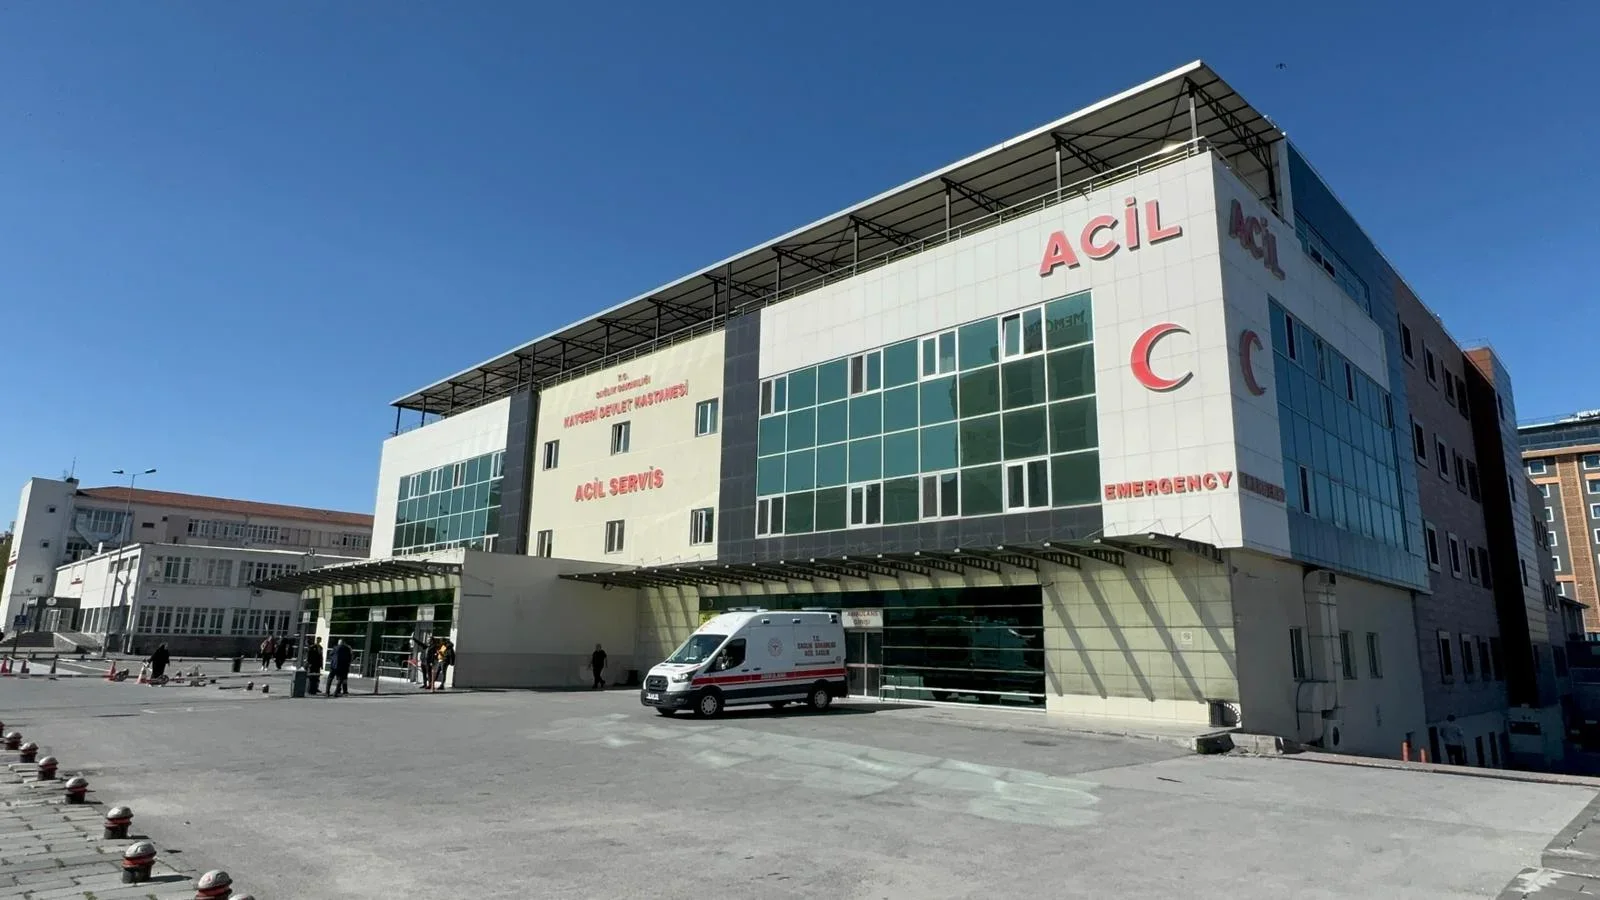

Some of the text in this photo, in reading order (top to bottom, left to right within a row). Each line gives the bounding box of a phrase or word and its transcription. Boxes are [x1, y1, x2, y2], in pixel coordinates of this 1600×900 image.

[1039, 196, 1183, 278] ACİL
[564, 379, 689, 428] KAYSERİ DEVLET HASTANESİ
[575, 465, 664, 502] ACİL SERVİS
[1104, 471, 1233, 501] EMERGENCY
